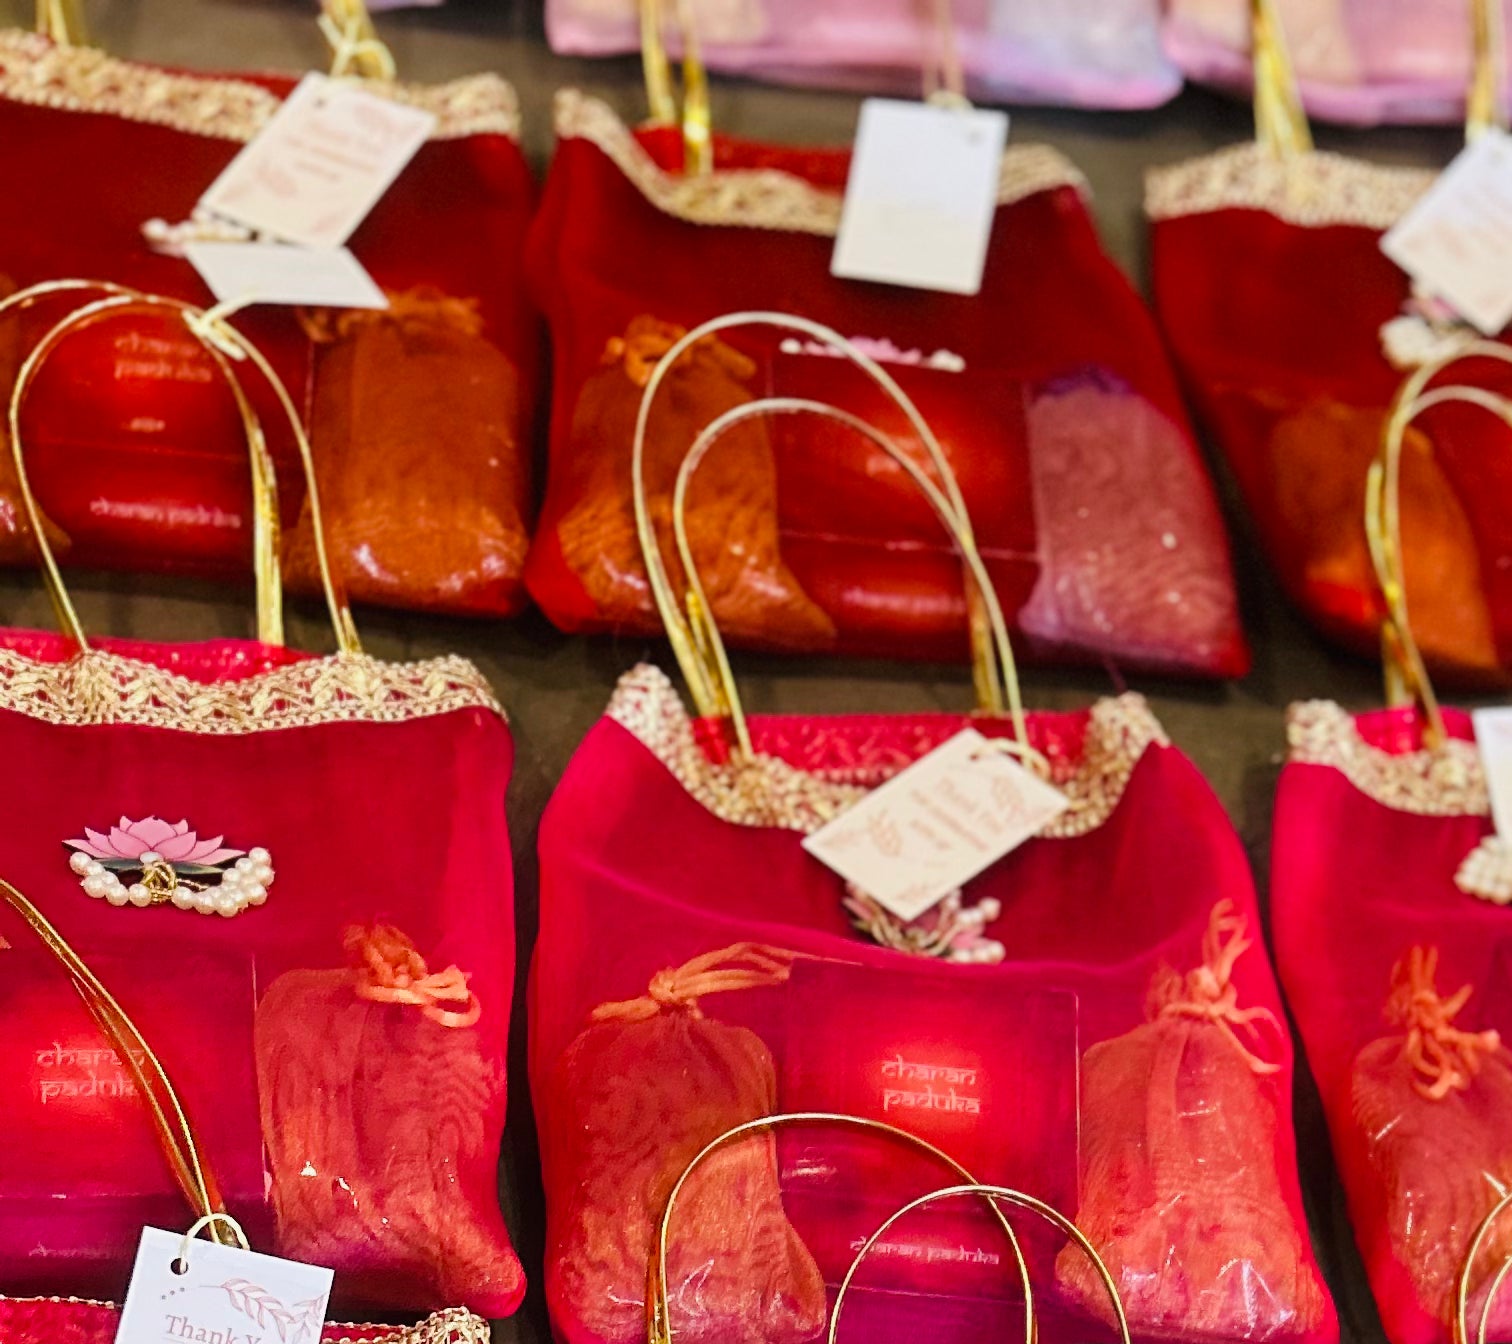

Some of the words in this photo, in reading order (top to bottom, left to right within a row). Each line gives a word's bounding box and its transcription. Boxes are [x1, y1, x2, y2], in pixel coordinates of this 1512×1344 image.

[881, 1054, 977, 1085] charan
[39, 1067, 140, 1104] paduk
[882, 1086, 981, 1113] paduka
